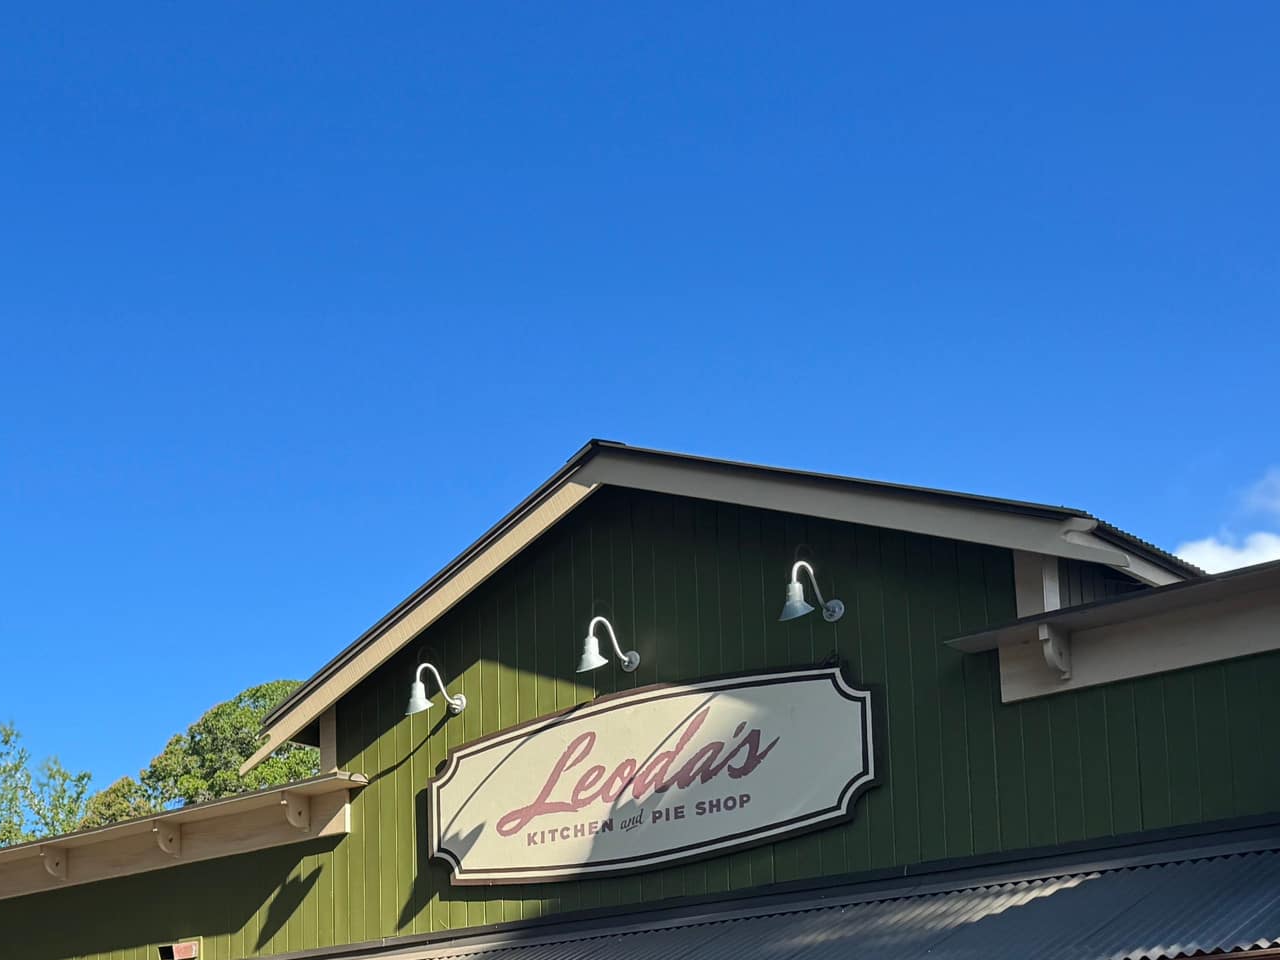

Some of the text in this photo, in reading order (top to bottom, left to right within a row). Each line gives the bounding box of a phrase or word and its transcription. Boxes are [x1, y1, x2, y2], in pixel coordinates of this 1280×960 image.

[496, 706, 780, 837] Leoda's
[527, 793, 752, 846] KITCHEN and PIE SHOP
